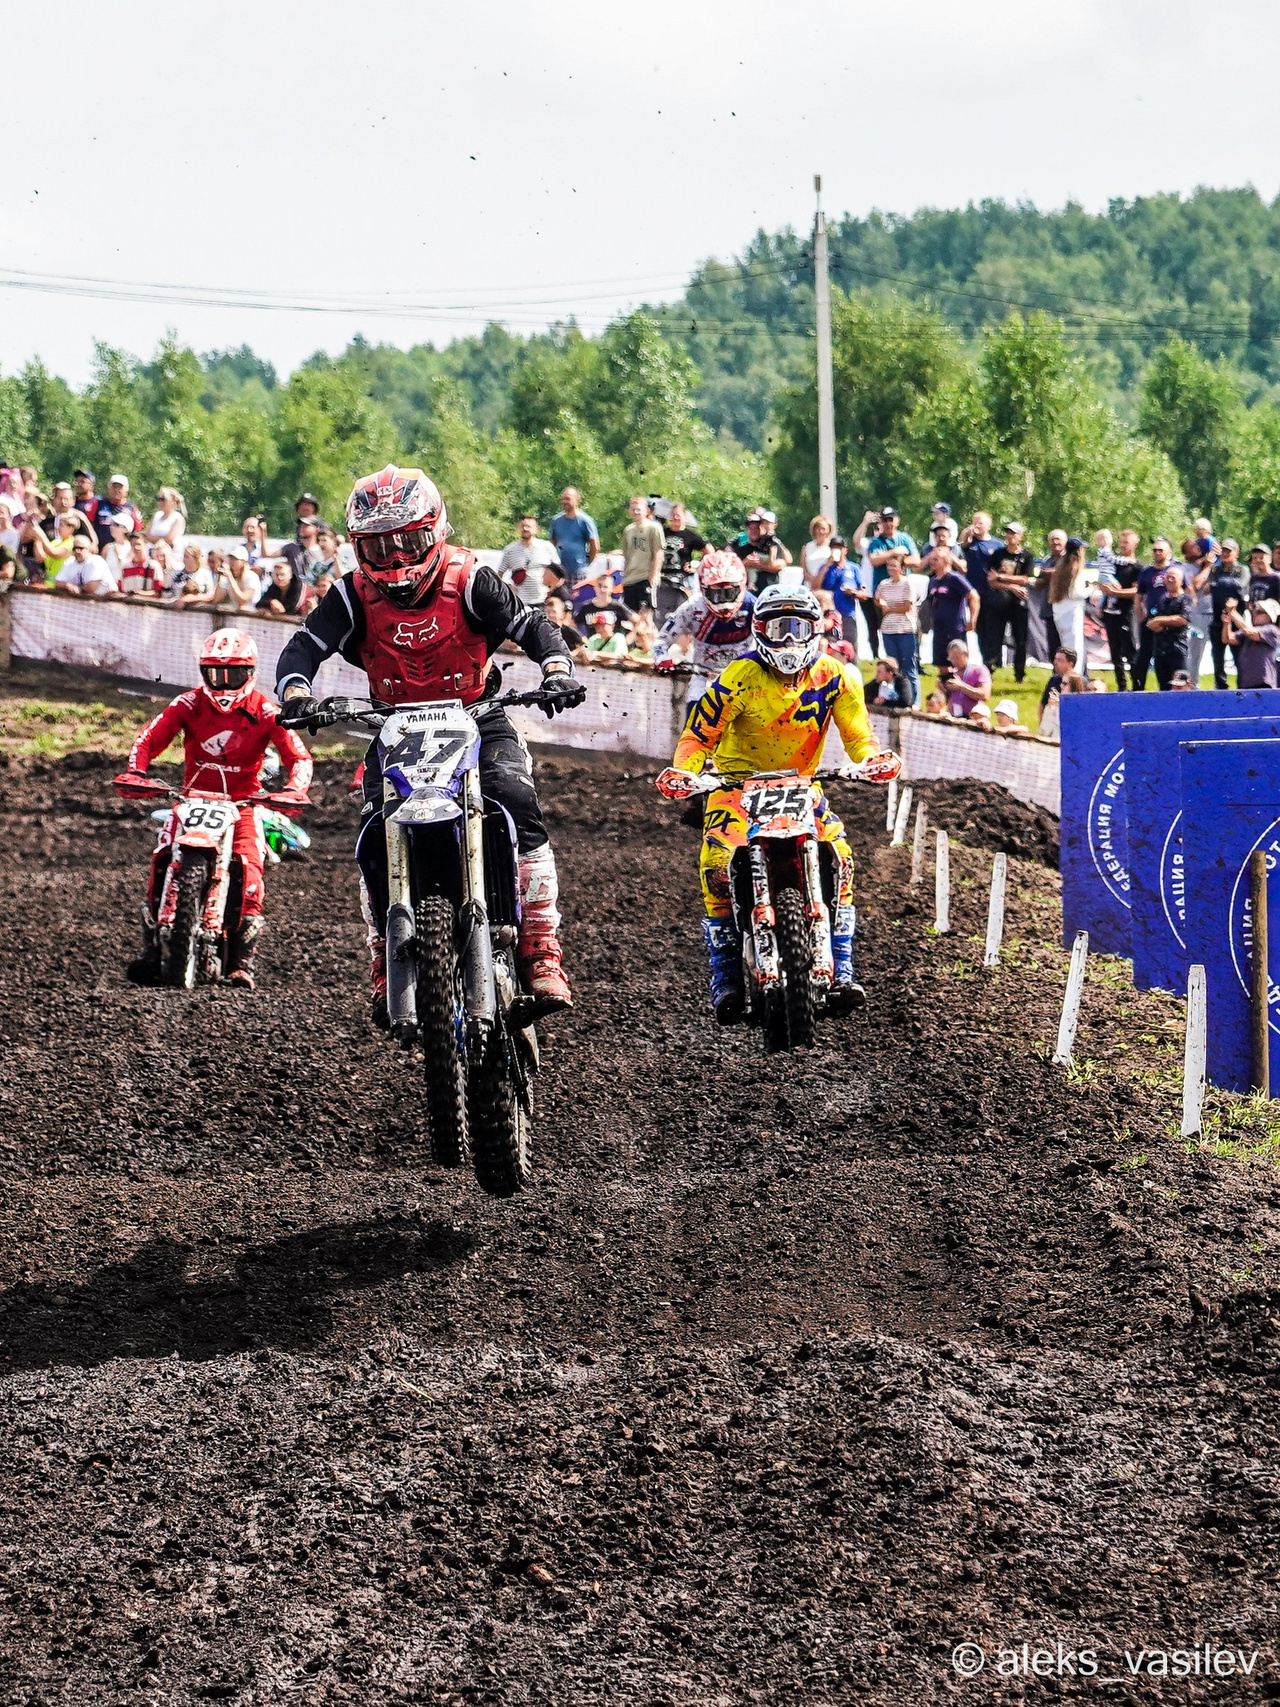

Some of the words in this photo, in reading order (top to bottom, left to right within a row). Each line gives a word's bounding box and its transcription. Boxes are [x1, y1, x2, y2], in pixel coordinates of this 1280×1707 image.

[406, 712, 448, 724] YAMAHA
[384, 729, 477, 768] 47
[750, 788, 809, 818] 125
[185, 807, 227, 830] 85
[1097, 803, 1131, 892] ЕДЕРАЦИЯ
